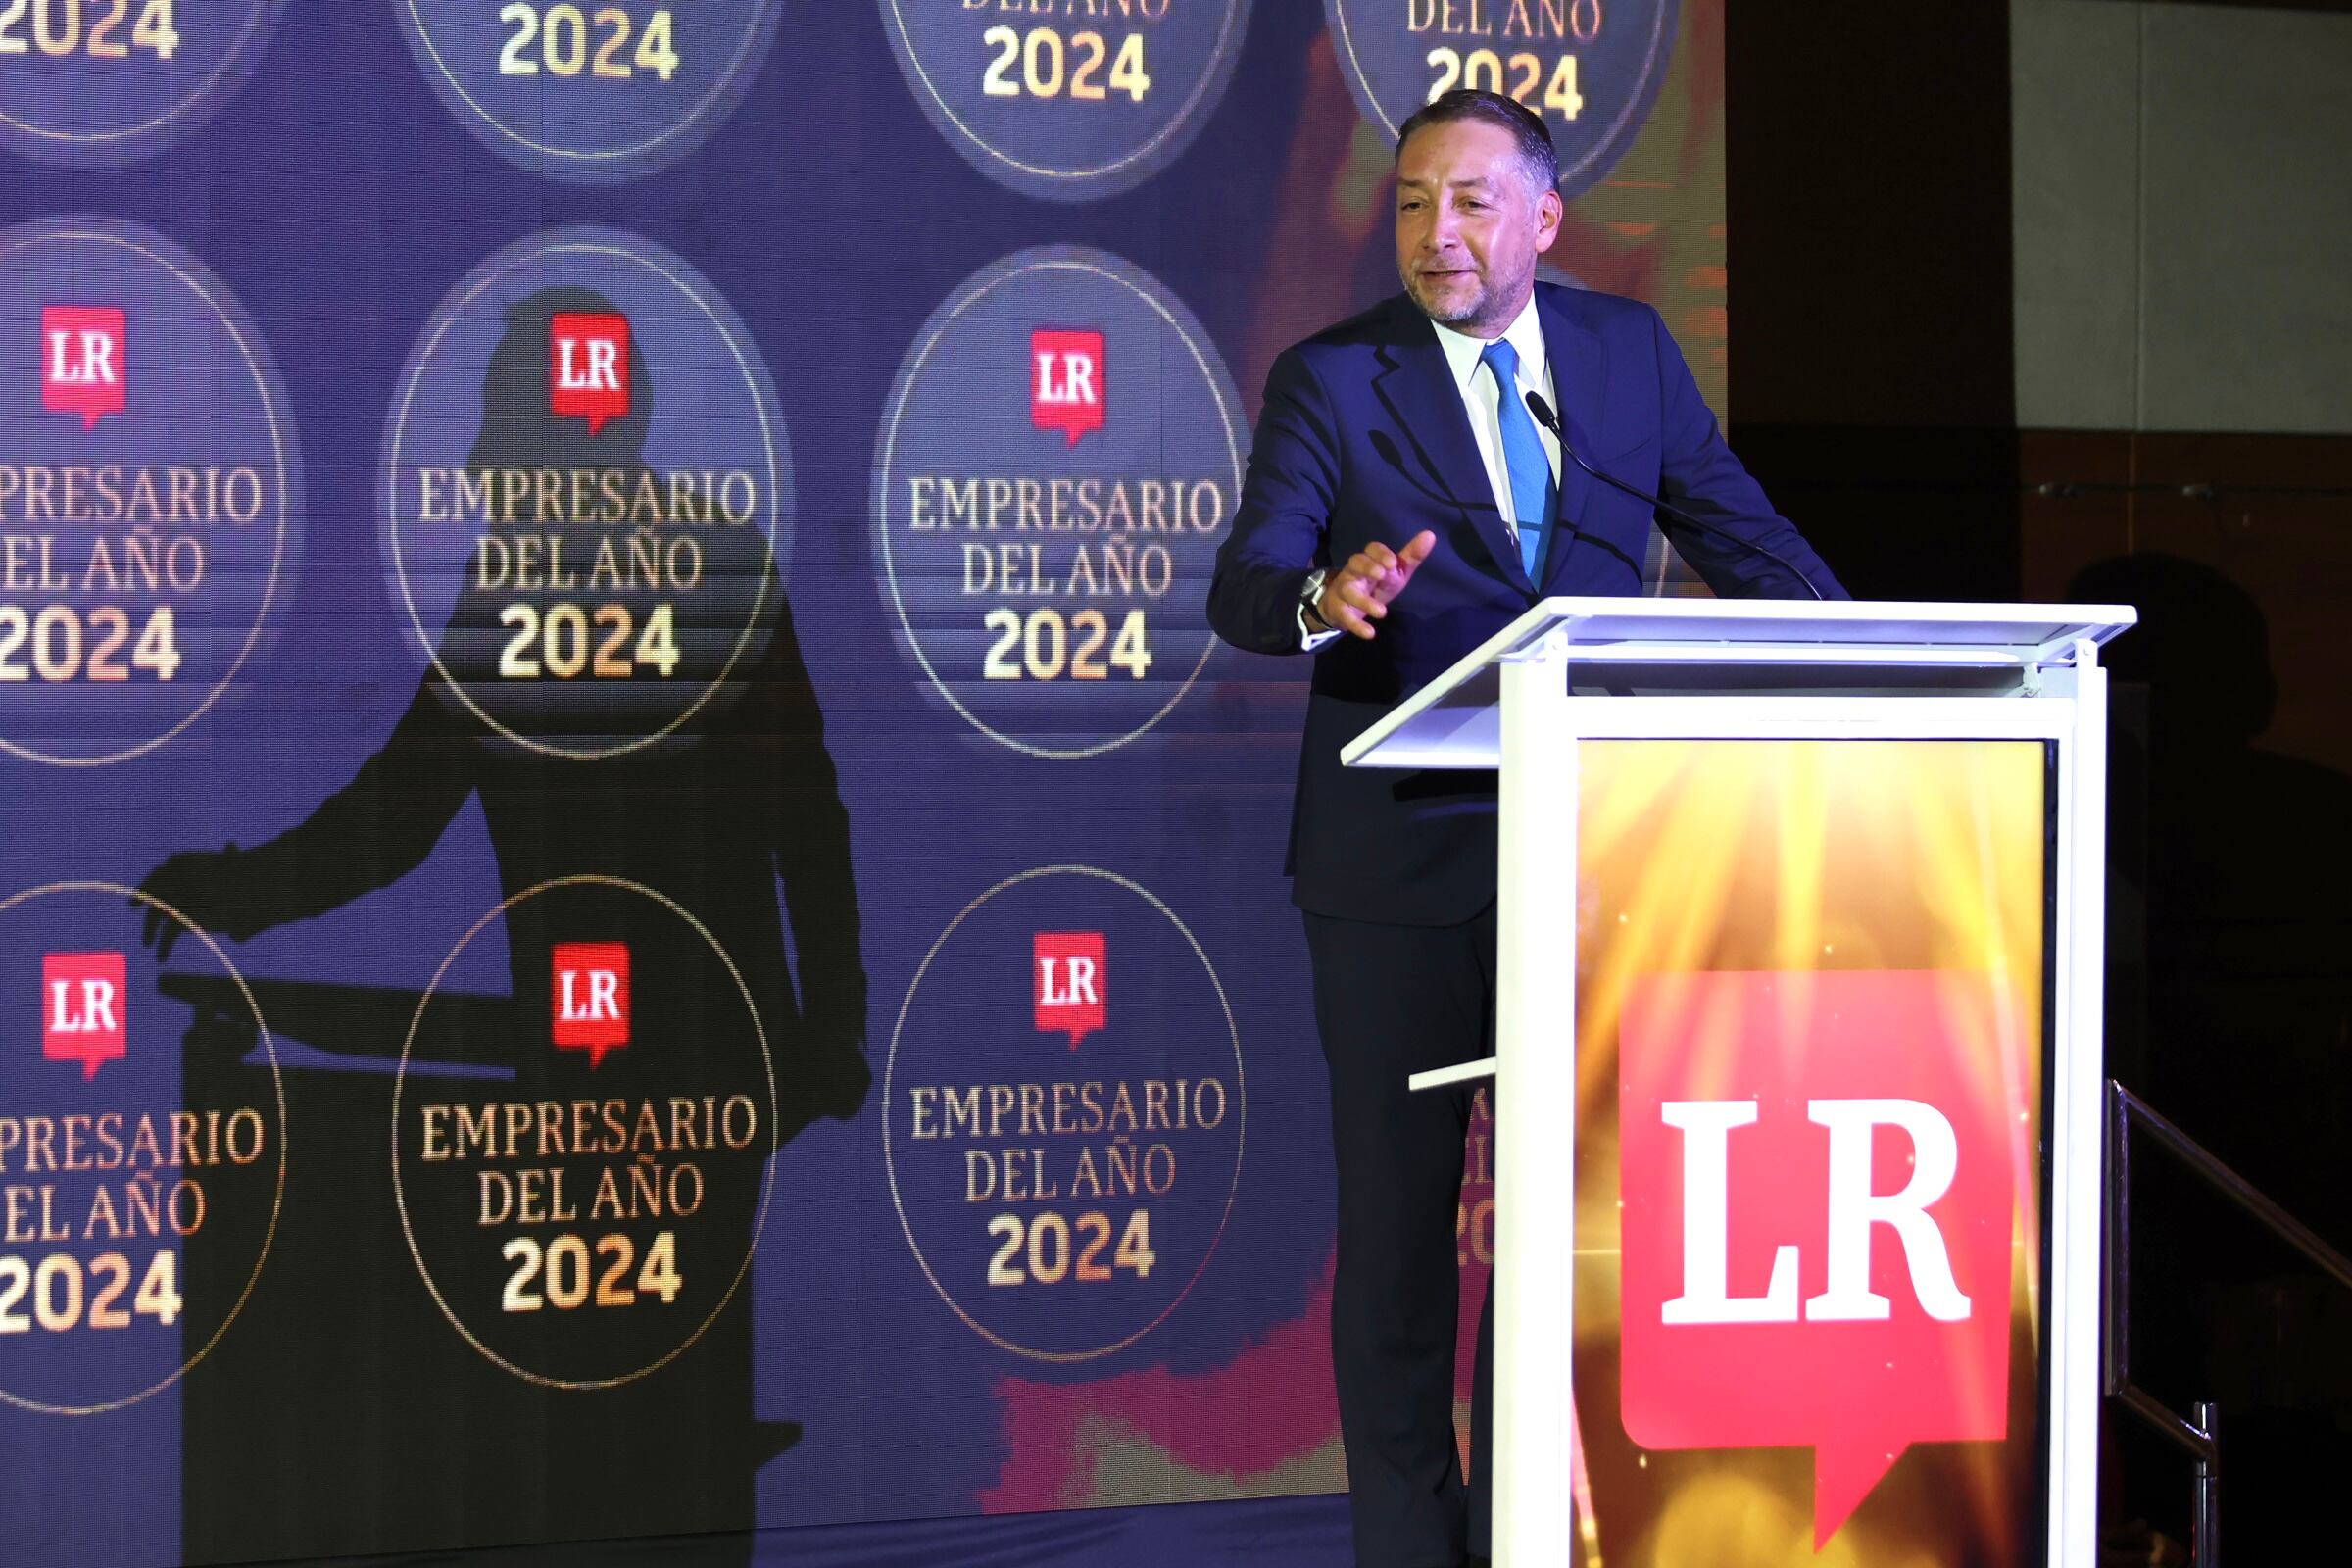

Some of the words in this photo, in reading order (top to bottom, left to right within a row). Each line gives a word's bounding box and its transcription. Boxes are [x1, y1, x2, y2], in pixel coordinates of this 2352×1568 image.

[0, 0, 180, 59] 2024
[499, 2, 679, 80] 2024
[983, 25, 1151, 102] 2024
[1427, 47, 1584, 121] 2024
[49, 330, 116, 383] LR
[557, 338, 620, 391] LR
[1035, 352, 1097, 405] LR
[418, 468, 757, 523] EMPRESARIO
[908, 478, 1222, 534] EMPRESARIO
[82, 526, 204, 594] AÑO
[477, 537, 575, 589] DEL
[592, 527, 704, 590] AÑO
[962, 543, 1056, 596] DEL
[1066, 533, 1173, 596] AÑO
[0, 604, 182, 682] 2024
[499, 603, 680, 678] 2024
[983, 609, 1152, 680] 2024
[51, 978, 116, 1032] LR
[561, 970, 621, 1021] LR
[1041, 956, 1098, 1005] LR
[420, 1094, 758, 1160] EMPRESARIO
[910, 1077, 1227, 1139] EMPRESARIO
[477, 1169, 577, 1225] DEL
[591, 1156, 705, 1223] AÑO
[964, 1148, 1057, 1201] DEL
[1070, 1137, 1177, 1198] AÑO
[82, 1170, 207, 1239] AÑO
[1661, 1099, 1972, 1325] LR
[501, 1231, 683, 1312] 2024
[987, 1210, 1156, 1287] 2024
[0, 1249, 184, 1334] 2024
